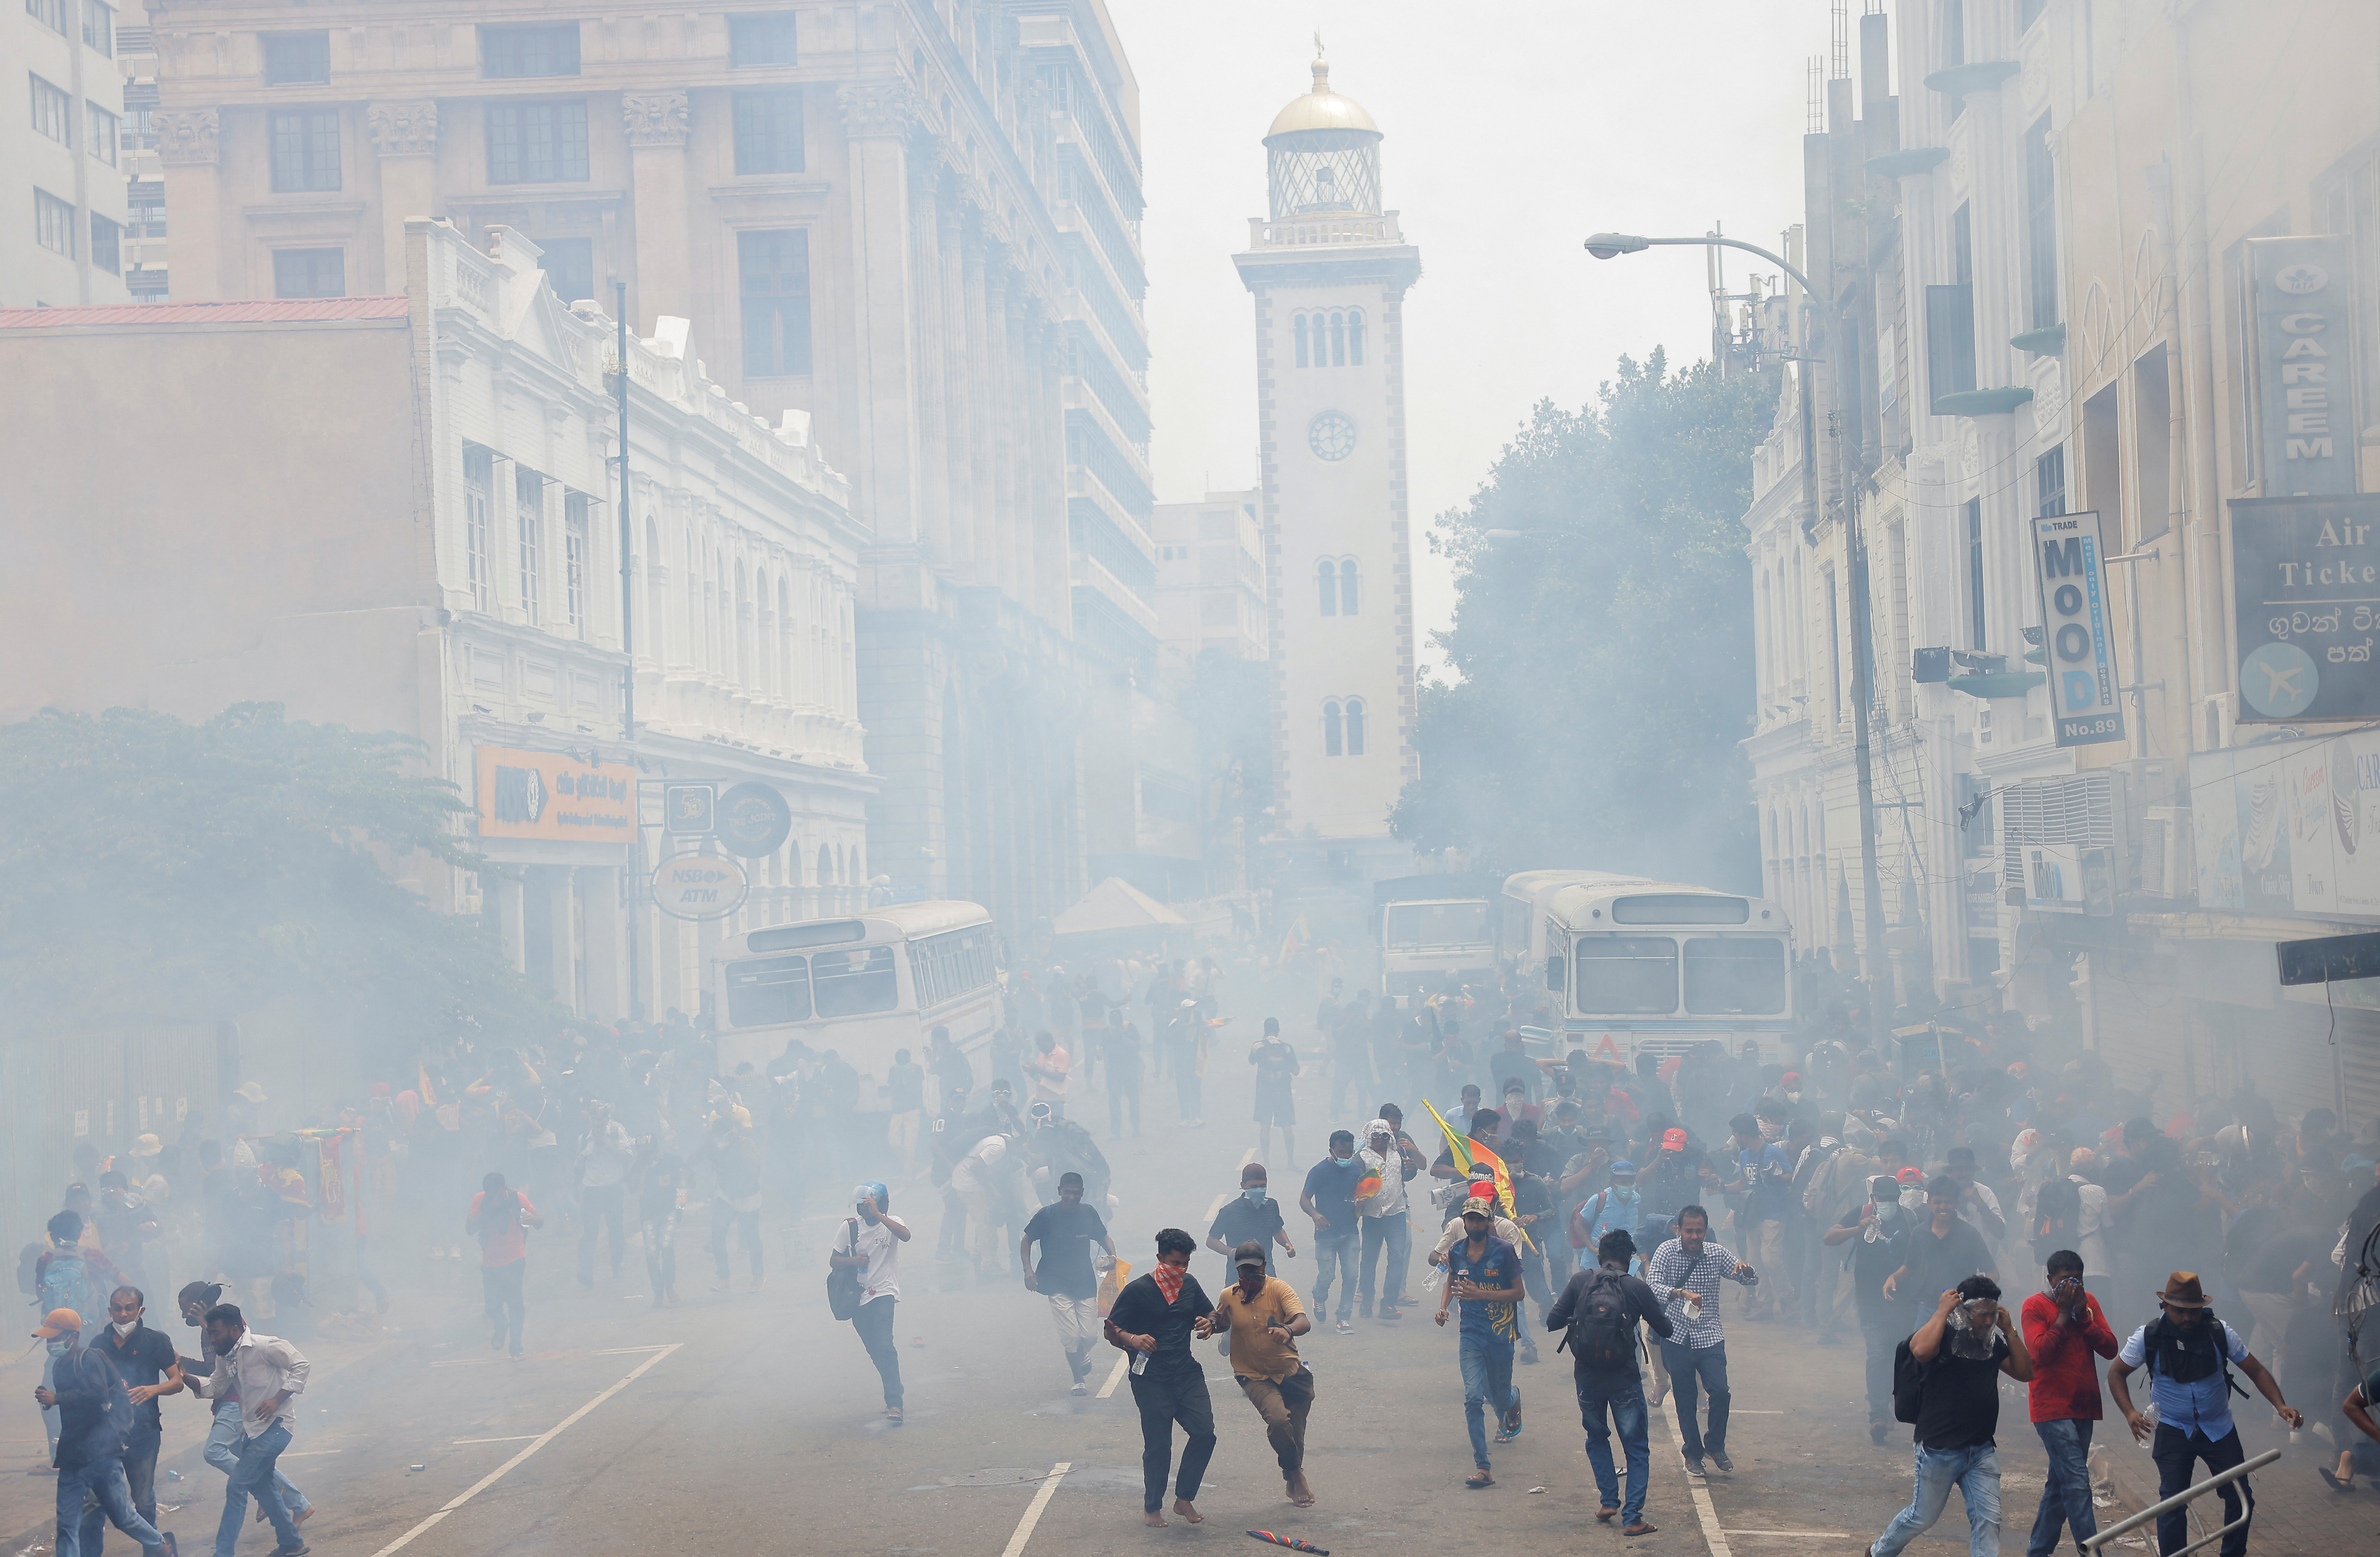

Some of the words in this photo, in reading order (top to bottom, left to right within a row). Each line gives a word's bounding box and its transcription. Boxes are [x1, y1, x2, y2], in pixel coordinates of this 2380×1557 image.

[2290, 282, 2314, 290] IATA
[2280, 313, 2333, 459] CAREEM
[2053, 521, 2078, 530] TRADE
[2316, 518, 2370, 547] Air
[2083, 537, 2092, 563] Meet
[2088, 571, 2097, 596] only
[2042, 537, 2095, 711] MOOD
[2091, 602, 2103, 654] Original
[2269, 607, 2342, 640] ගුවන්
[2327, 637, 2374, 663] පත්
[2065, 719, 2117, 737] No.89
[728, 818, 746, 826] THE
[749, 812, 776, 824] JOINT
[672, 869, 704, 884] NSB
[2307, 874, 2324, 896] Tours
[680, 889, 718, 902] ATM
[932, 1118, 946, 1133] 10
